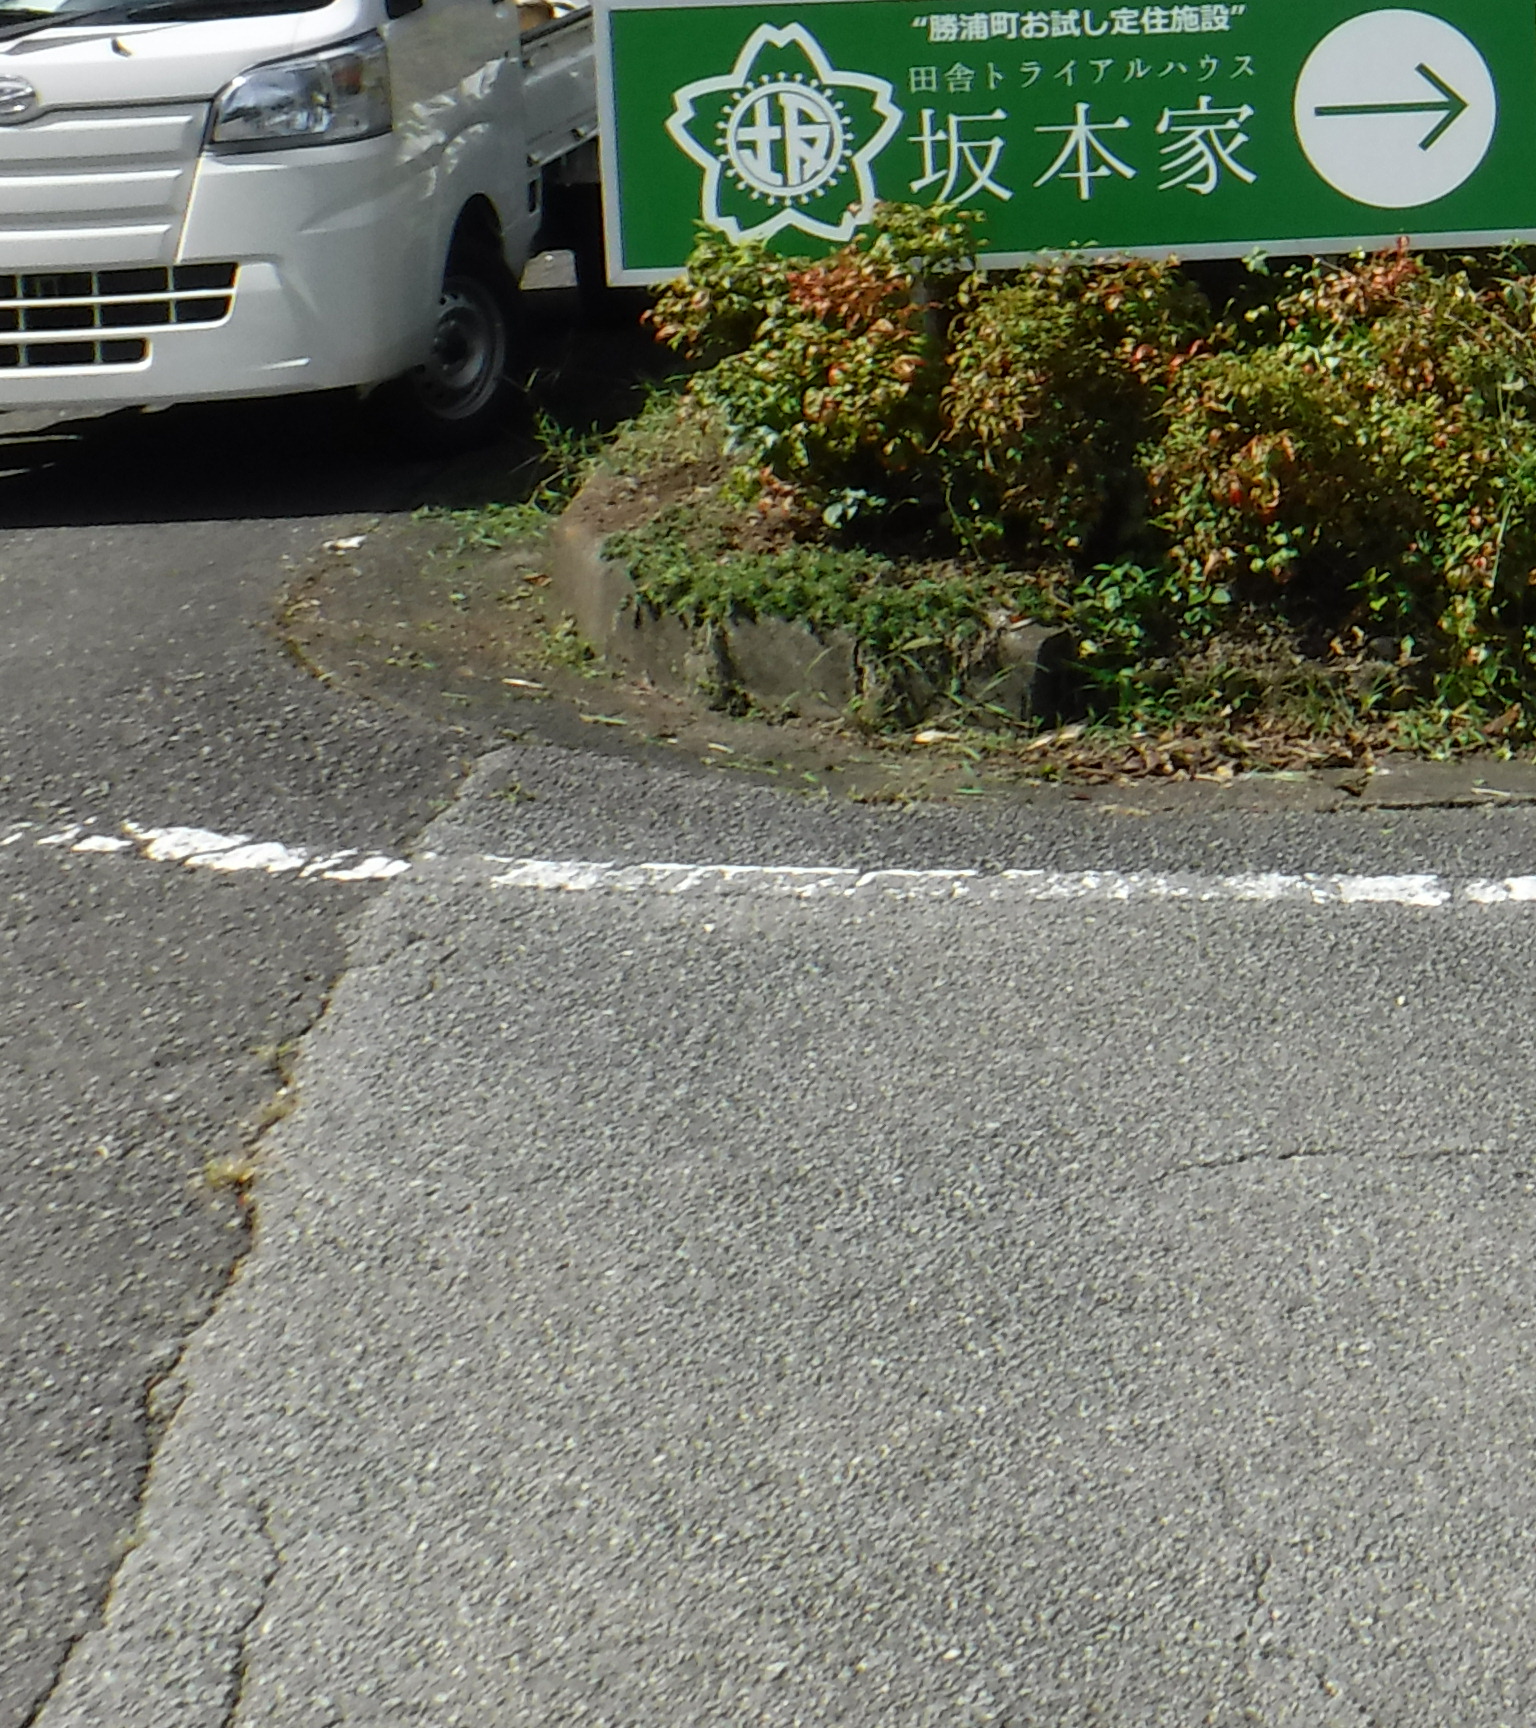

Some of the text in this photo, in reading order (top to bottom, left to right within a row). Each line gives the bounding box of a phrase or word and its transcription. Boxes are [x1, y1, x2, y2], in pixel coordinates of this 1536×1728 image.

[908, 53, 1255, 95] 田舎トライアルハウス
[906, 93, 1258, 205] 坂本家
